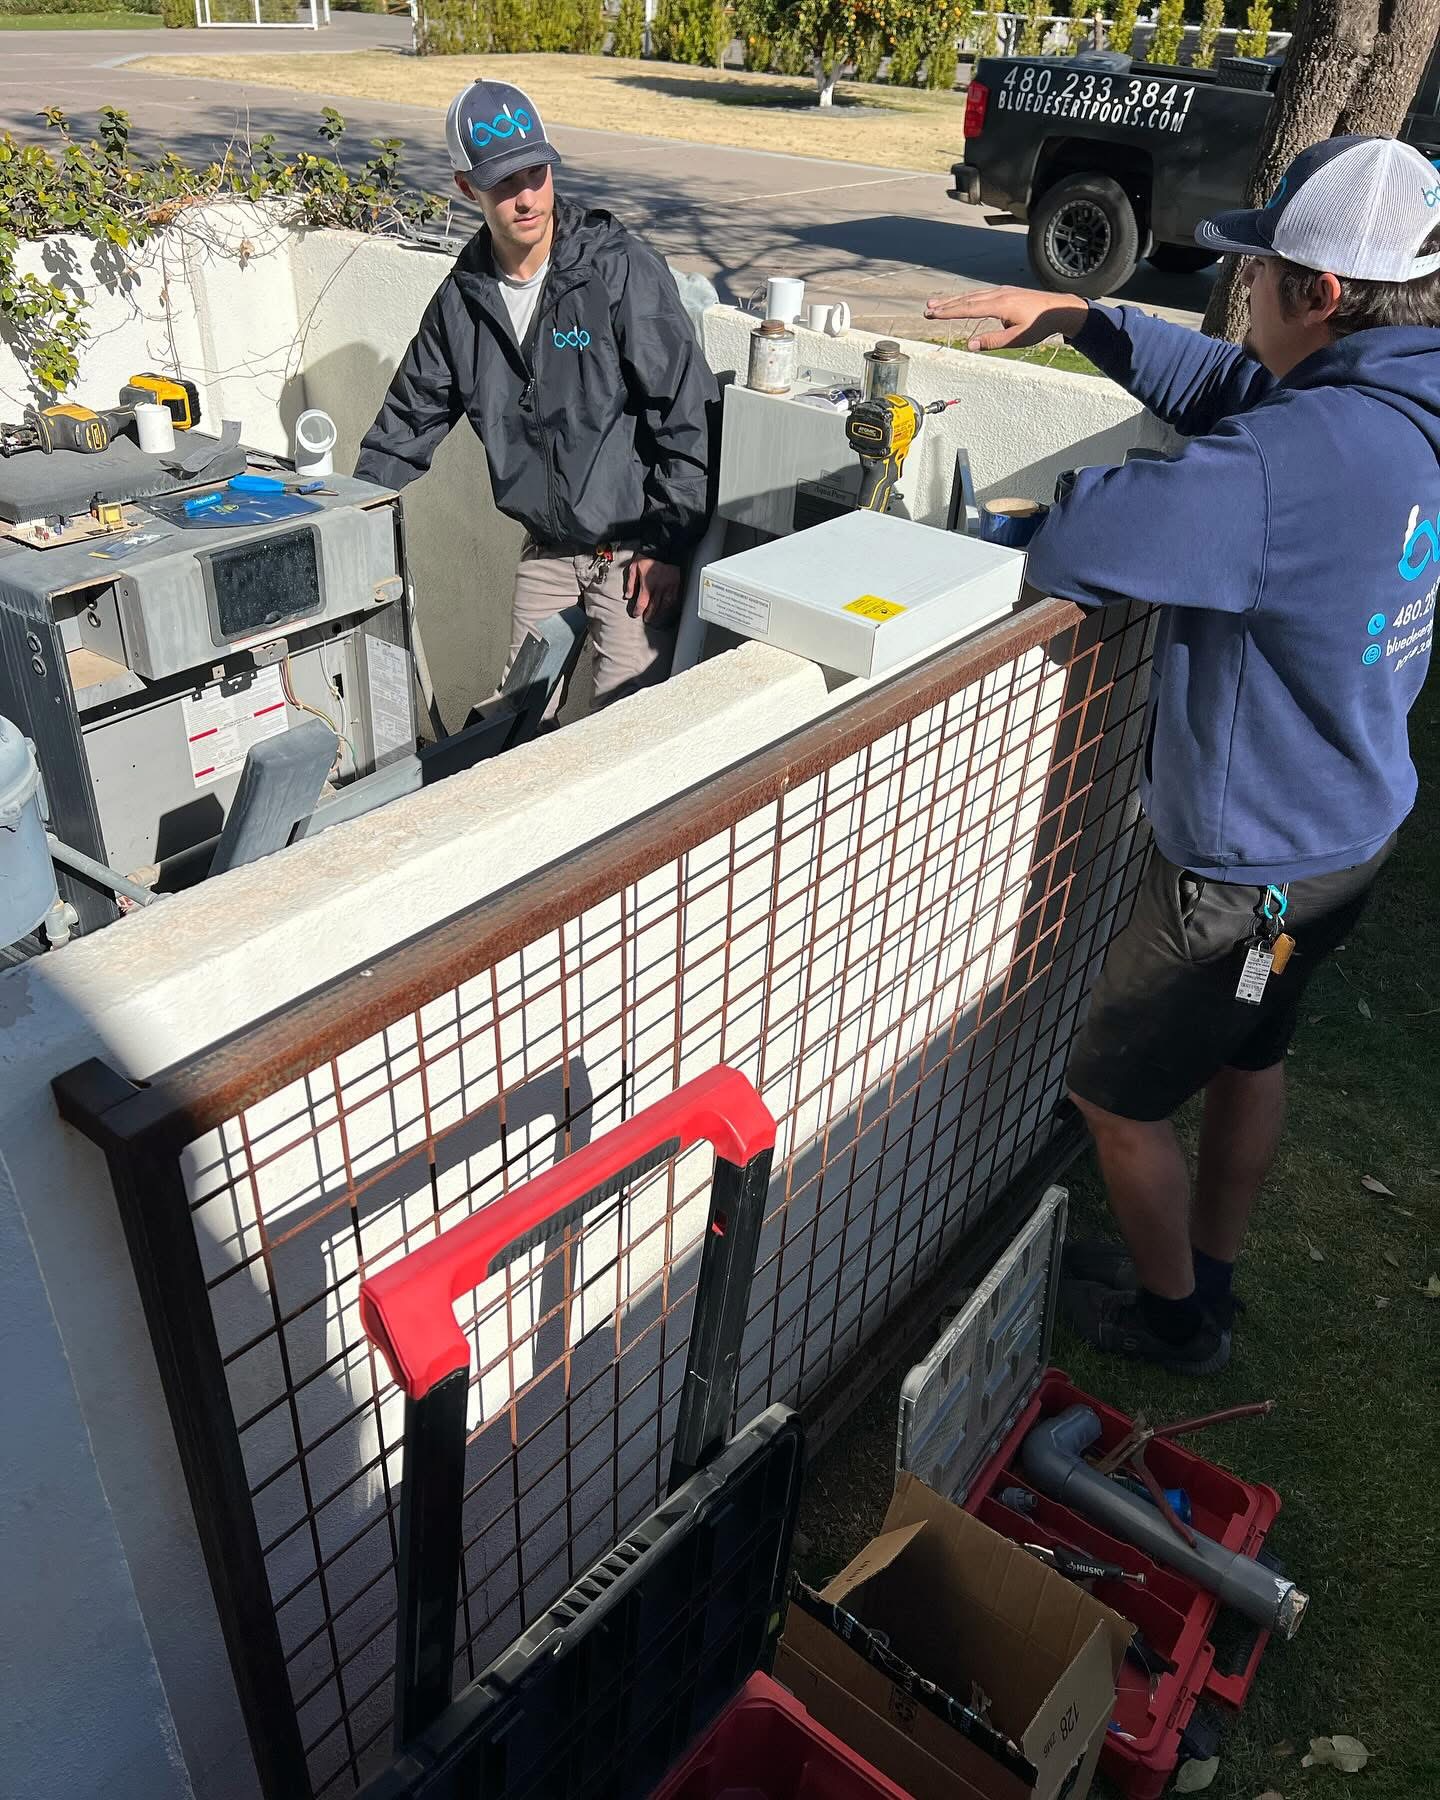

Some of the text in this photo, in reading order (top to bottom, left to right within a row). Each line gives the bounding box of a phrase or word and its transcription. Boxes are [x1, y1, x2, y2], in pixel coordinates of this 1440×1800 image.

[1003, 65, 1196, 113] 480.233.3841
[998, 90, 1186, 133] BLUEDESERTPOOLS.COM
[1076, 1563, 1105, 1577] HUSKY
[1060, 1701, 1080, 1741] 128
